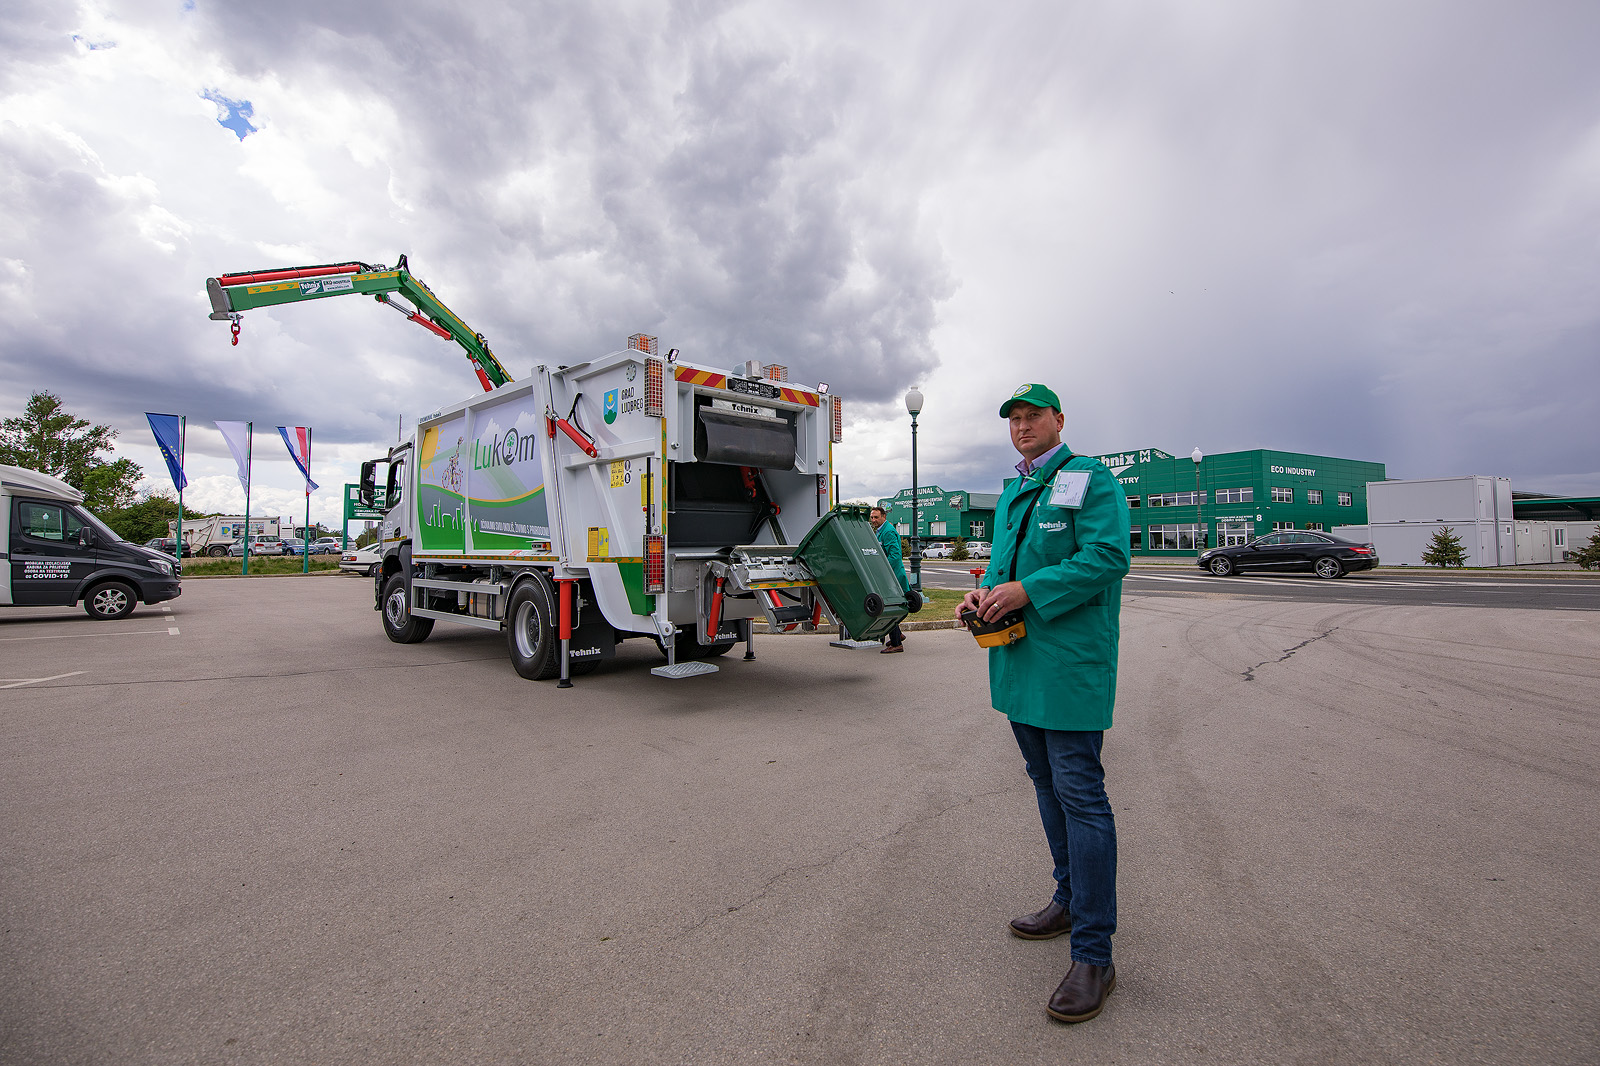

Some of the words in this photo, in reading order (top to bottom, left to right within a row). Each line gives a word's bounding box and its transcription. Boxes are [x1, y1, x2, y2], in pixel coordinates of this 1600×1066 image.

[621, 386, 635, 400] GRAD
[731, 403, 759, 415] Tehnix
[1270, 465, 1284, 474] ECO
[1285, 466, 1317, 477] INDUSTRY
[1117, 476, 1140, 485] STRY
[1256, 514, 1263, 522] 8
[1039, 520, 1067, 529] Tehnix
[569, 646, 601, 658] Tehnix
